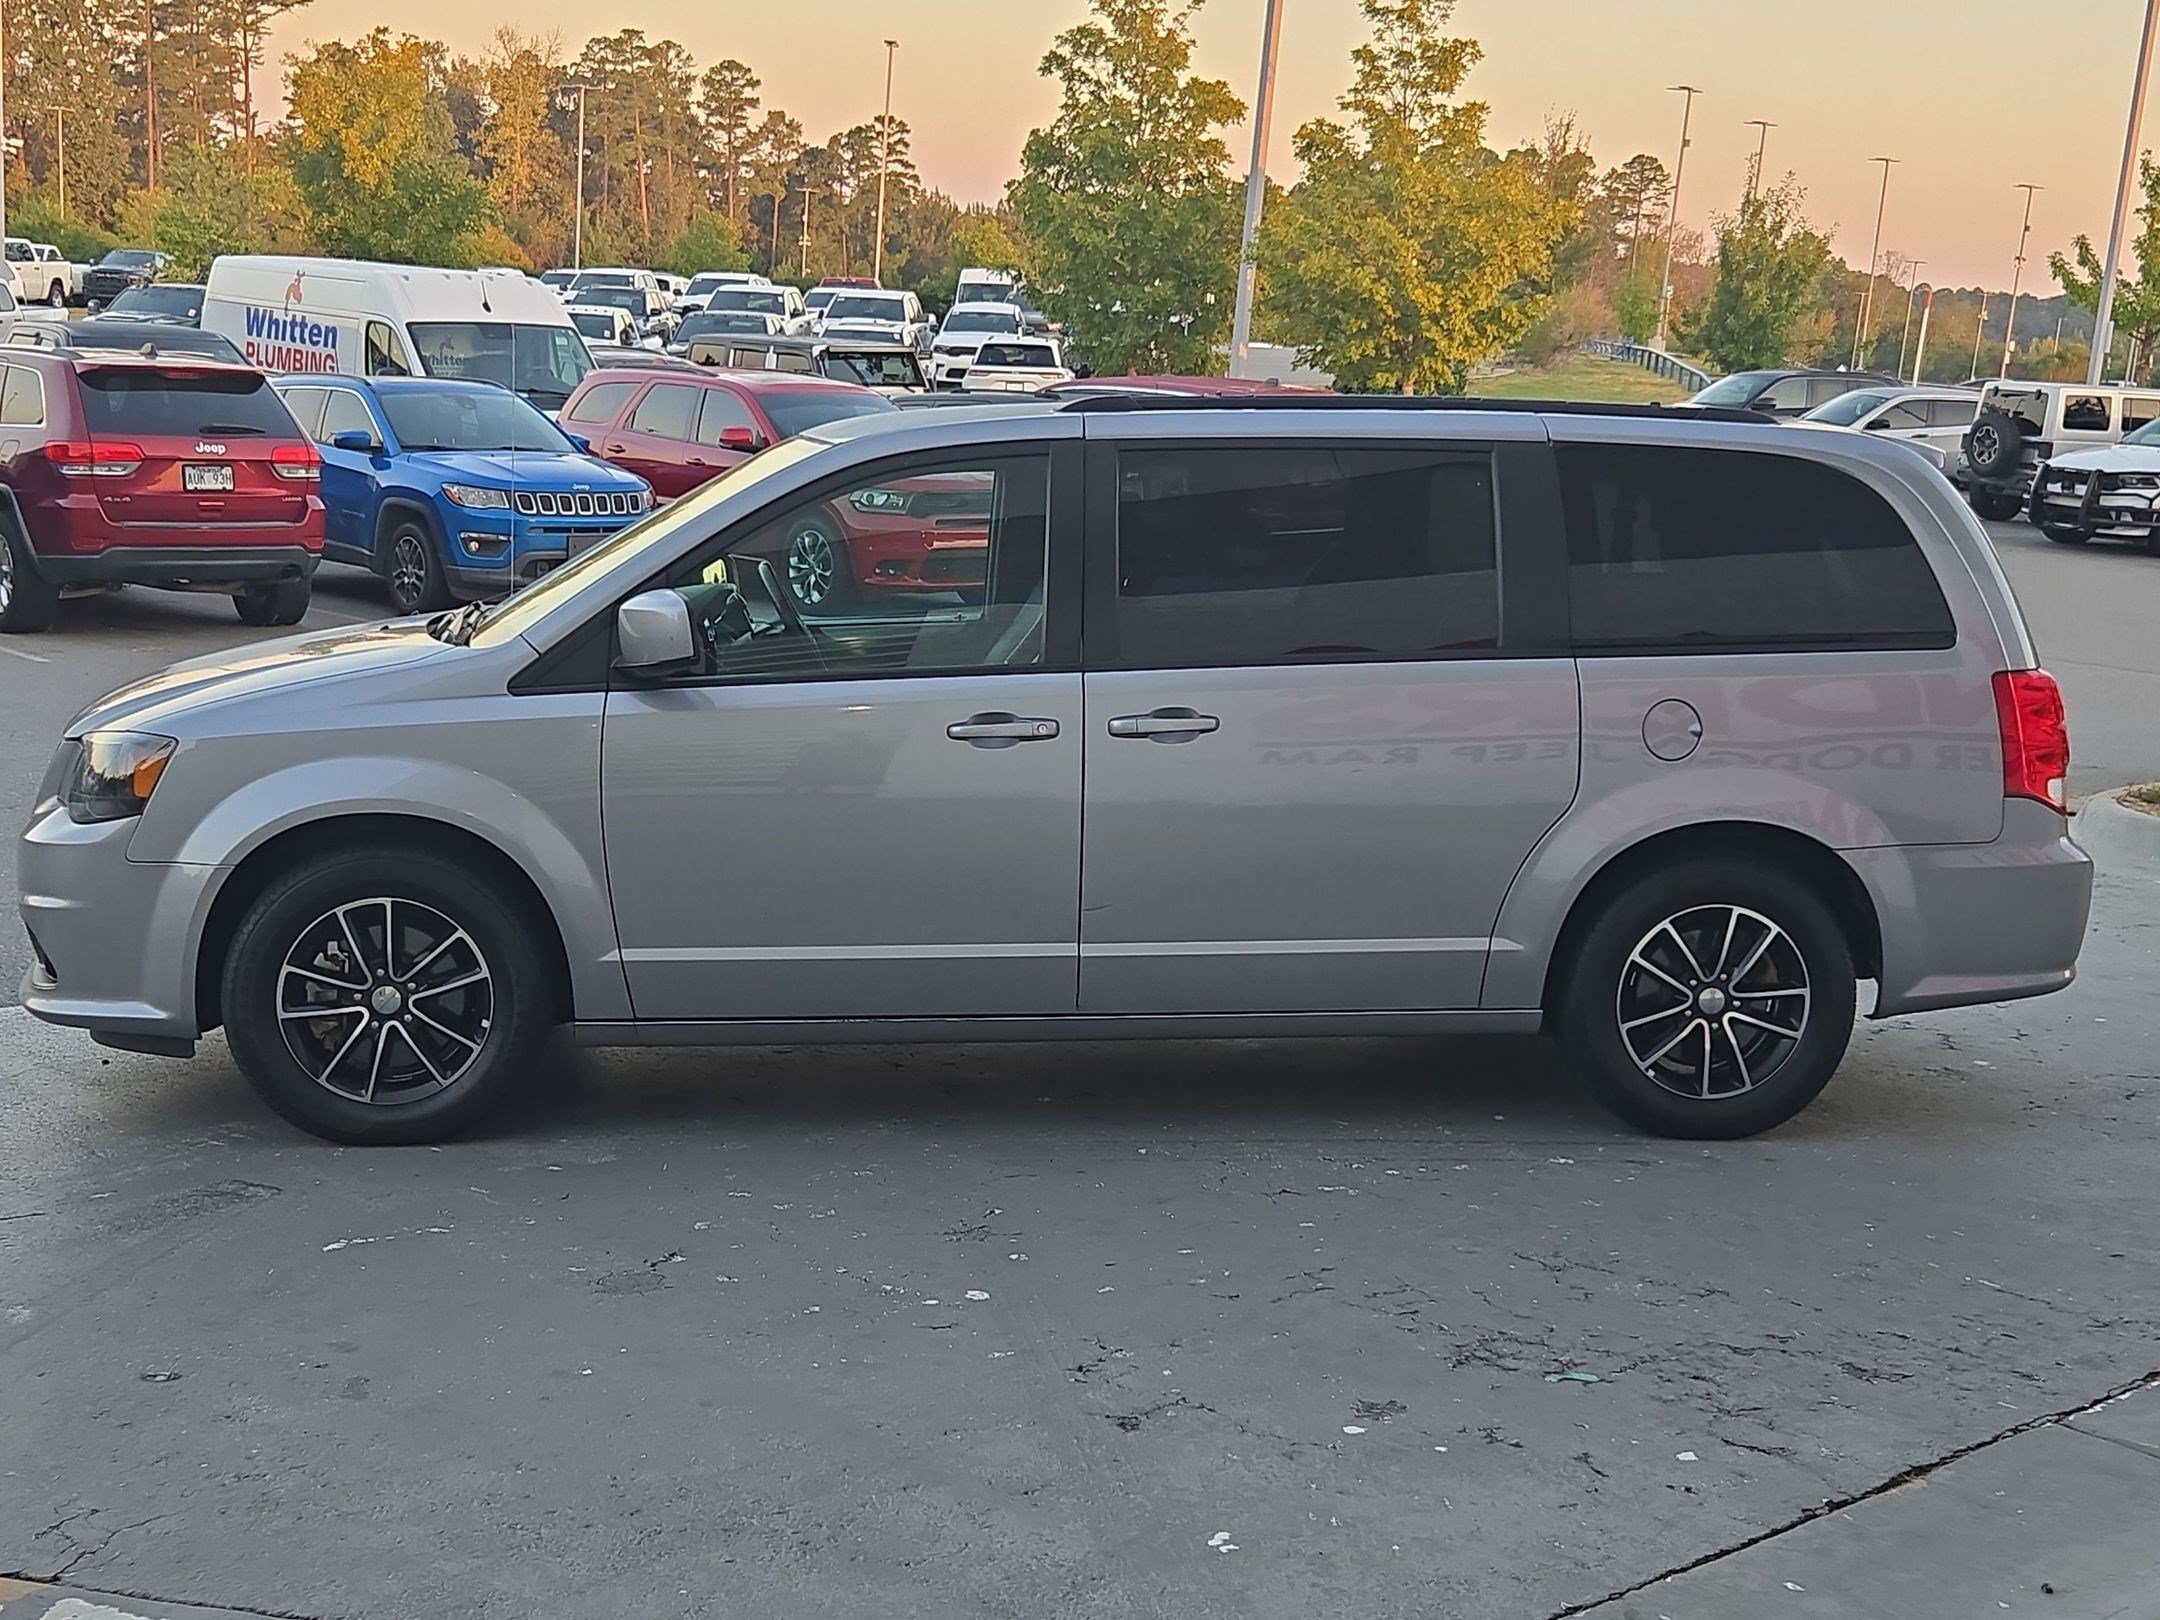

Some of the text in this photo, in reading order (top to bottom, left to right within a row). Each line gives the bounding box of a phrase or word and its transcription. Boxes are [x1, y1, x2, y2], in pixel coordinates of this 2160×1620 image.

[245, 306, 338, 349] Whitten
[245, 341, 336, 373] PLUMBING
[195, 441, 227, 456] Jeep
[212, 472, 232, 486] 93H
